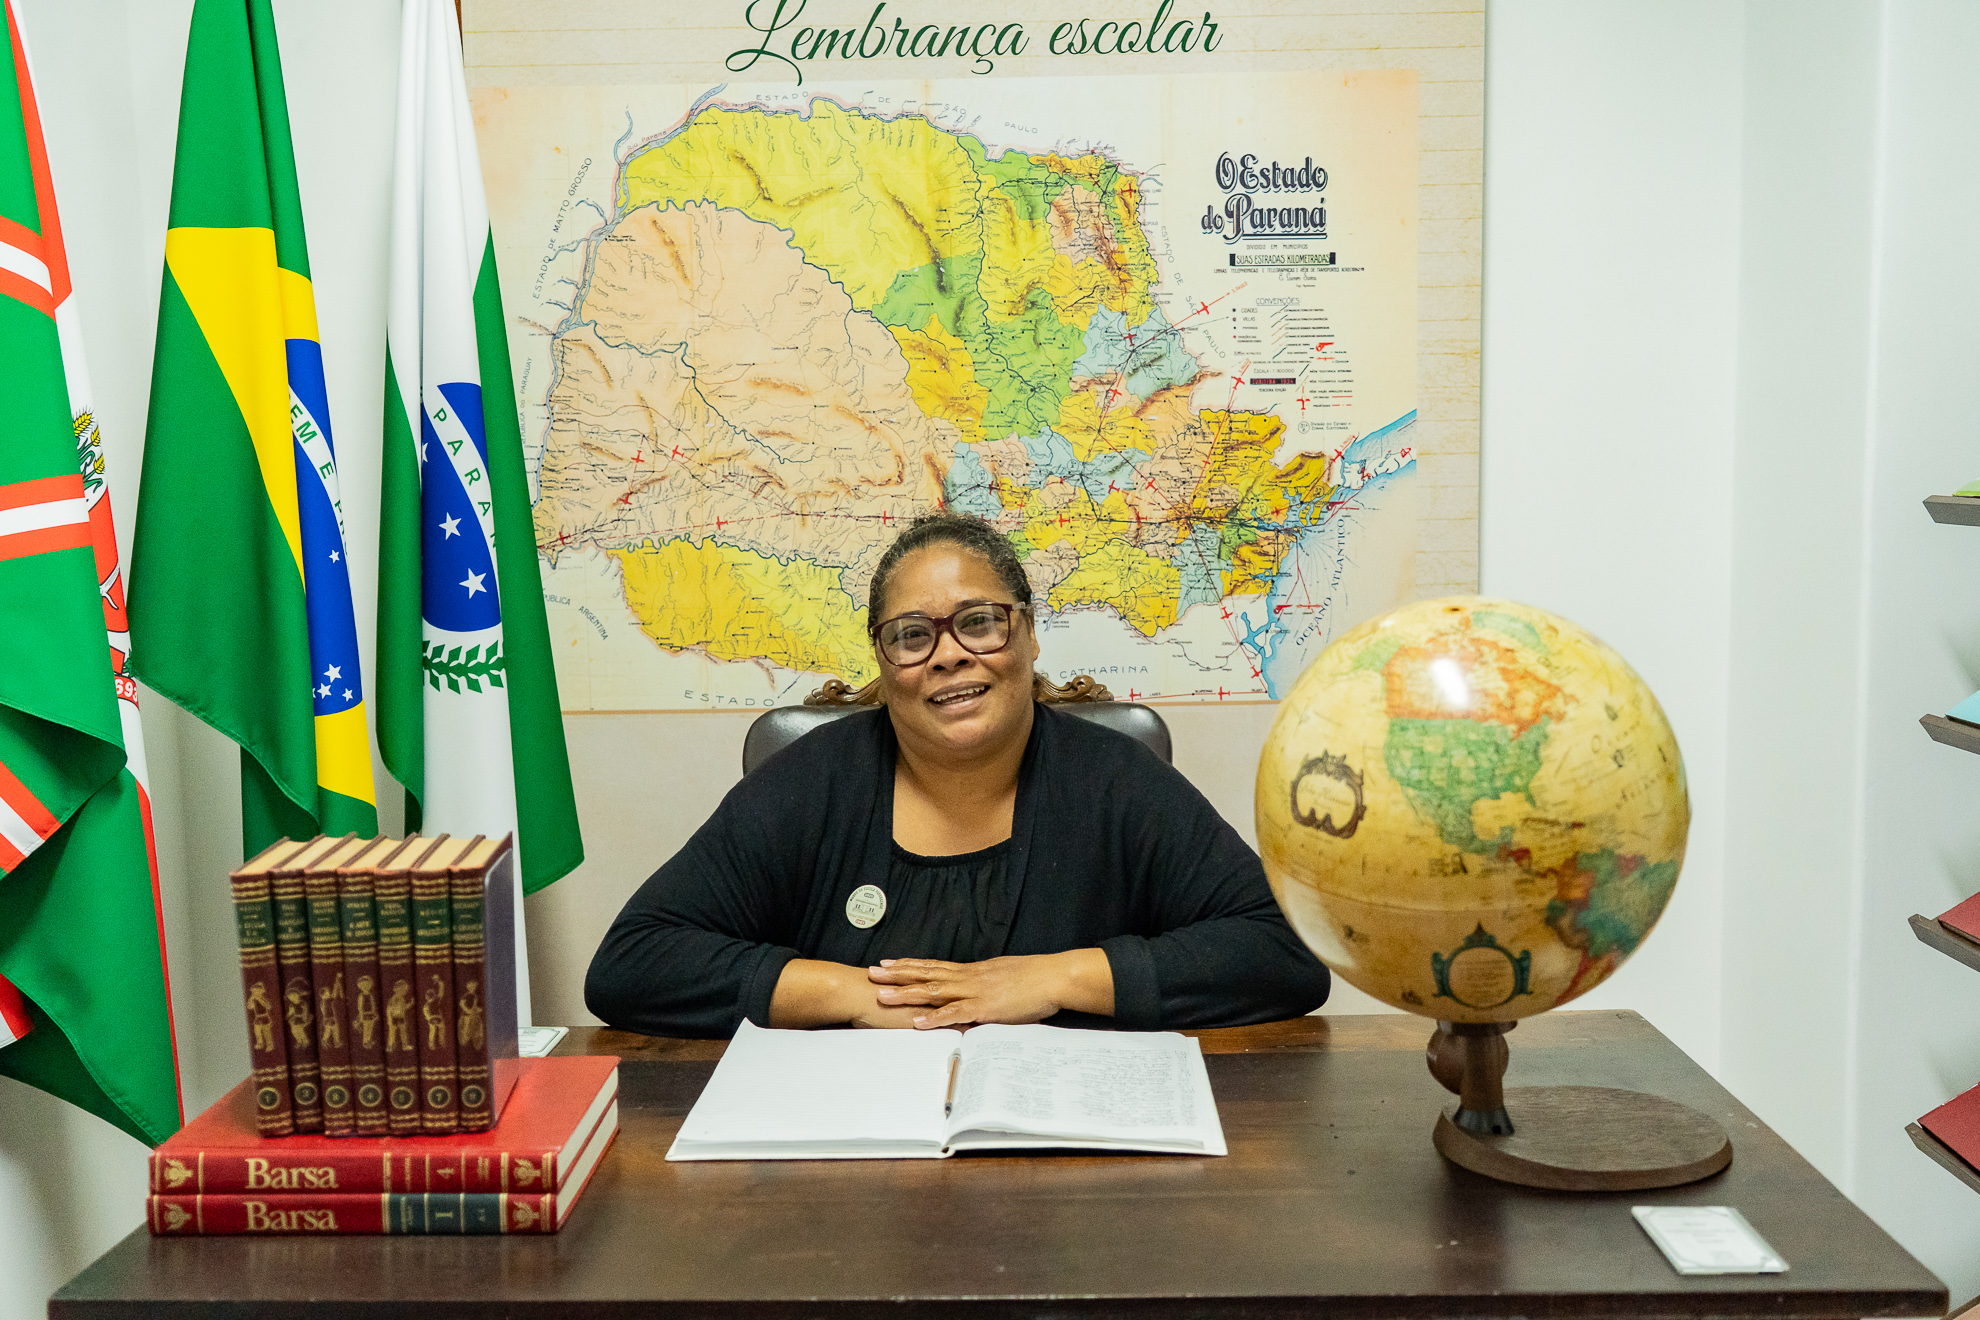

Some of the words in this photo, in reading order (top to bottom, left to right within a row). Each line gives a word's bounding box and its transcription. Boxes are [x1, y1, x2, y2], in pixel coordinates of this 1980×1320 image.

[726, 0, 1031, 86] Lembrança
[1049, 0, 1223, 57] escolar
[756, 90, 809, 102] ESTADO
[878, 96, 891, 104] DE
[943, 103, 967, 115] SÃO
[1004, 121, 1038, 134] PAULO
[1239, 153, 1328, 194] Estado
[532, 255, 552, 300] ESTADO
[548, 238, 556, 250] DE
[552, 199, 570, 233] MATTO
[568, 157, 592, 197] GROSSO
[1201, 204, 1225, 234] do
[1222, 193, 1327, 245] Paraná
[1236, 255, 1253, 265] SUAS
[1254, 254, 1285, 265] ESTRADAS
[1287, 253, 1331, 264] KILOMETRADAS
[1161, 226, 1174, 263] ESTADO
[1174, 272, 1184, 286] DE
[1185, 295, 1199, 316] SÃO
[1202, 329, 1226, 359] PAULO
[1255, 296, 1300, 305] CONVENÇÕES
[521, 357, 532, 395] PARAGUAY
[319, 461, 334, 480] E
[1295, 596, 1332, 646] OCEANO
[1330, 518, 1346, 591] ATLANTICO
[578, 605, 609, 641] ARGENTINA
[1059, 665, 1149, 679] CATHARINA
[684, 689, 775, 707] ESTADO
[244, 1158, 339, 1190] Barsa
[244, 1201, 338, 1231] Barsa
